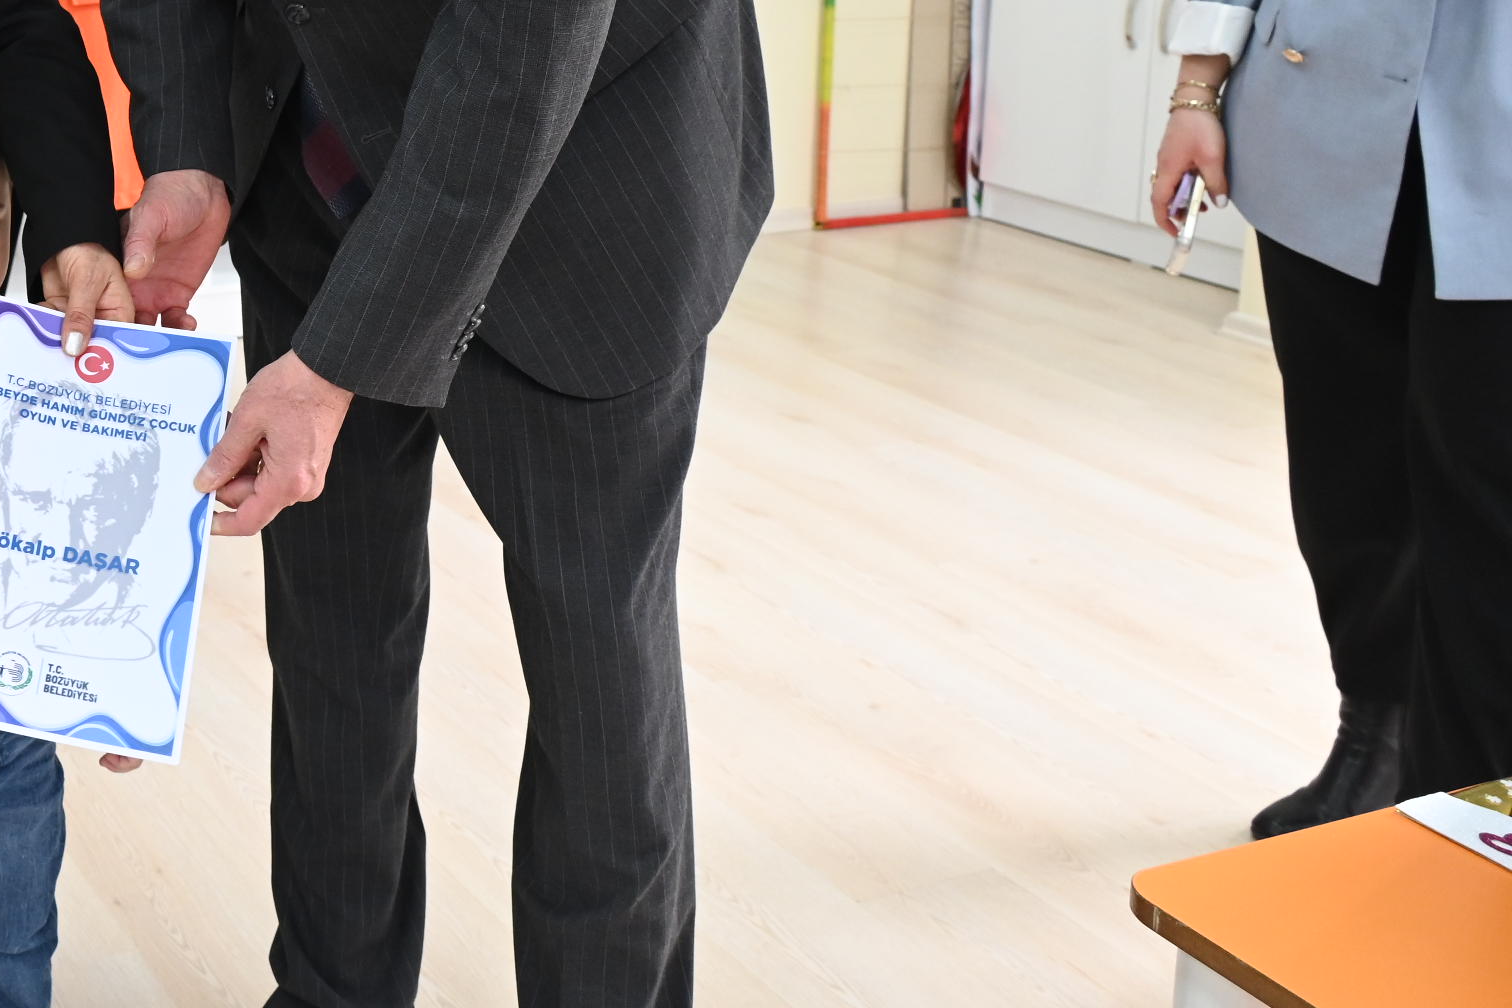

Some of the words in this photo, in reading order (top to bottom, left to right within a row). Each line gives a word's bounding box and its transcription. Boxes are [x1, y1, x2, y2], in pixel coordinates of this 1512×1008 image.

[95, 394, 172, 416] BELEDİYESİ
[19, 408, 57, 426] OYUN
[61, 418, 78, 430] VE
[82, 423, 148, 442] BAKIMEVİ
[41, 398, 85, 418] HANIM
[89, 407, 146, 427] GÜNDÜZ
[149, 417, 197, 435] ÇOCUK
[62, 546, 140, 575] DAŞAR
[48, 663, 64, 675] T.C.
[45, 673, 90, 691] BOZÜYÜK
[43, 684, 98, 703] BELEDİYESİ
